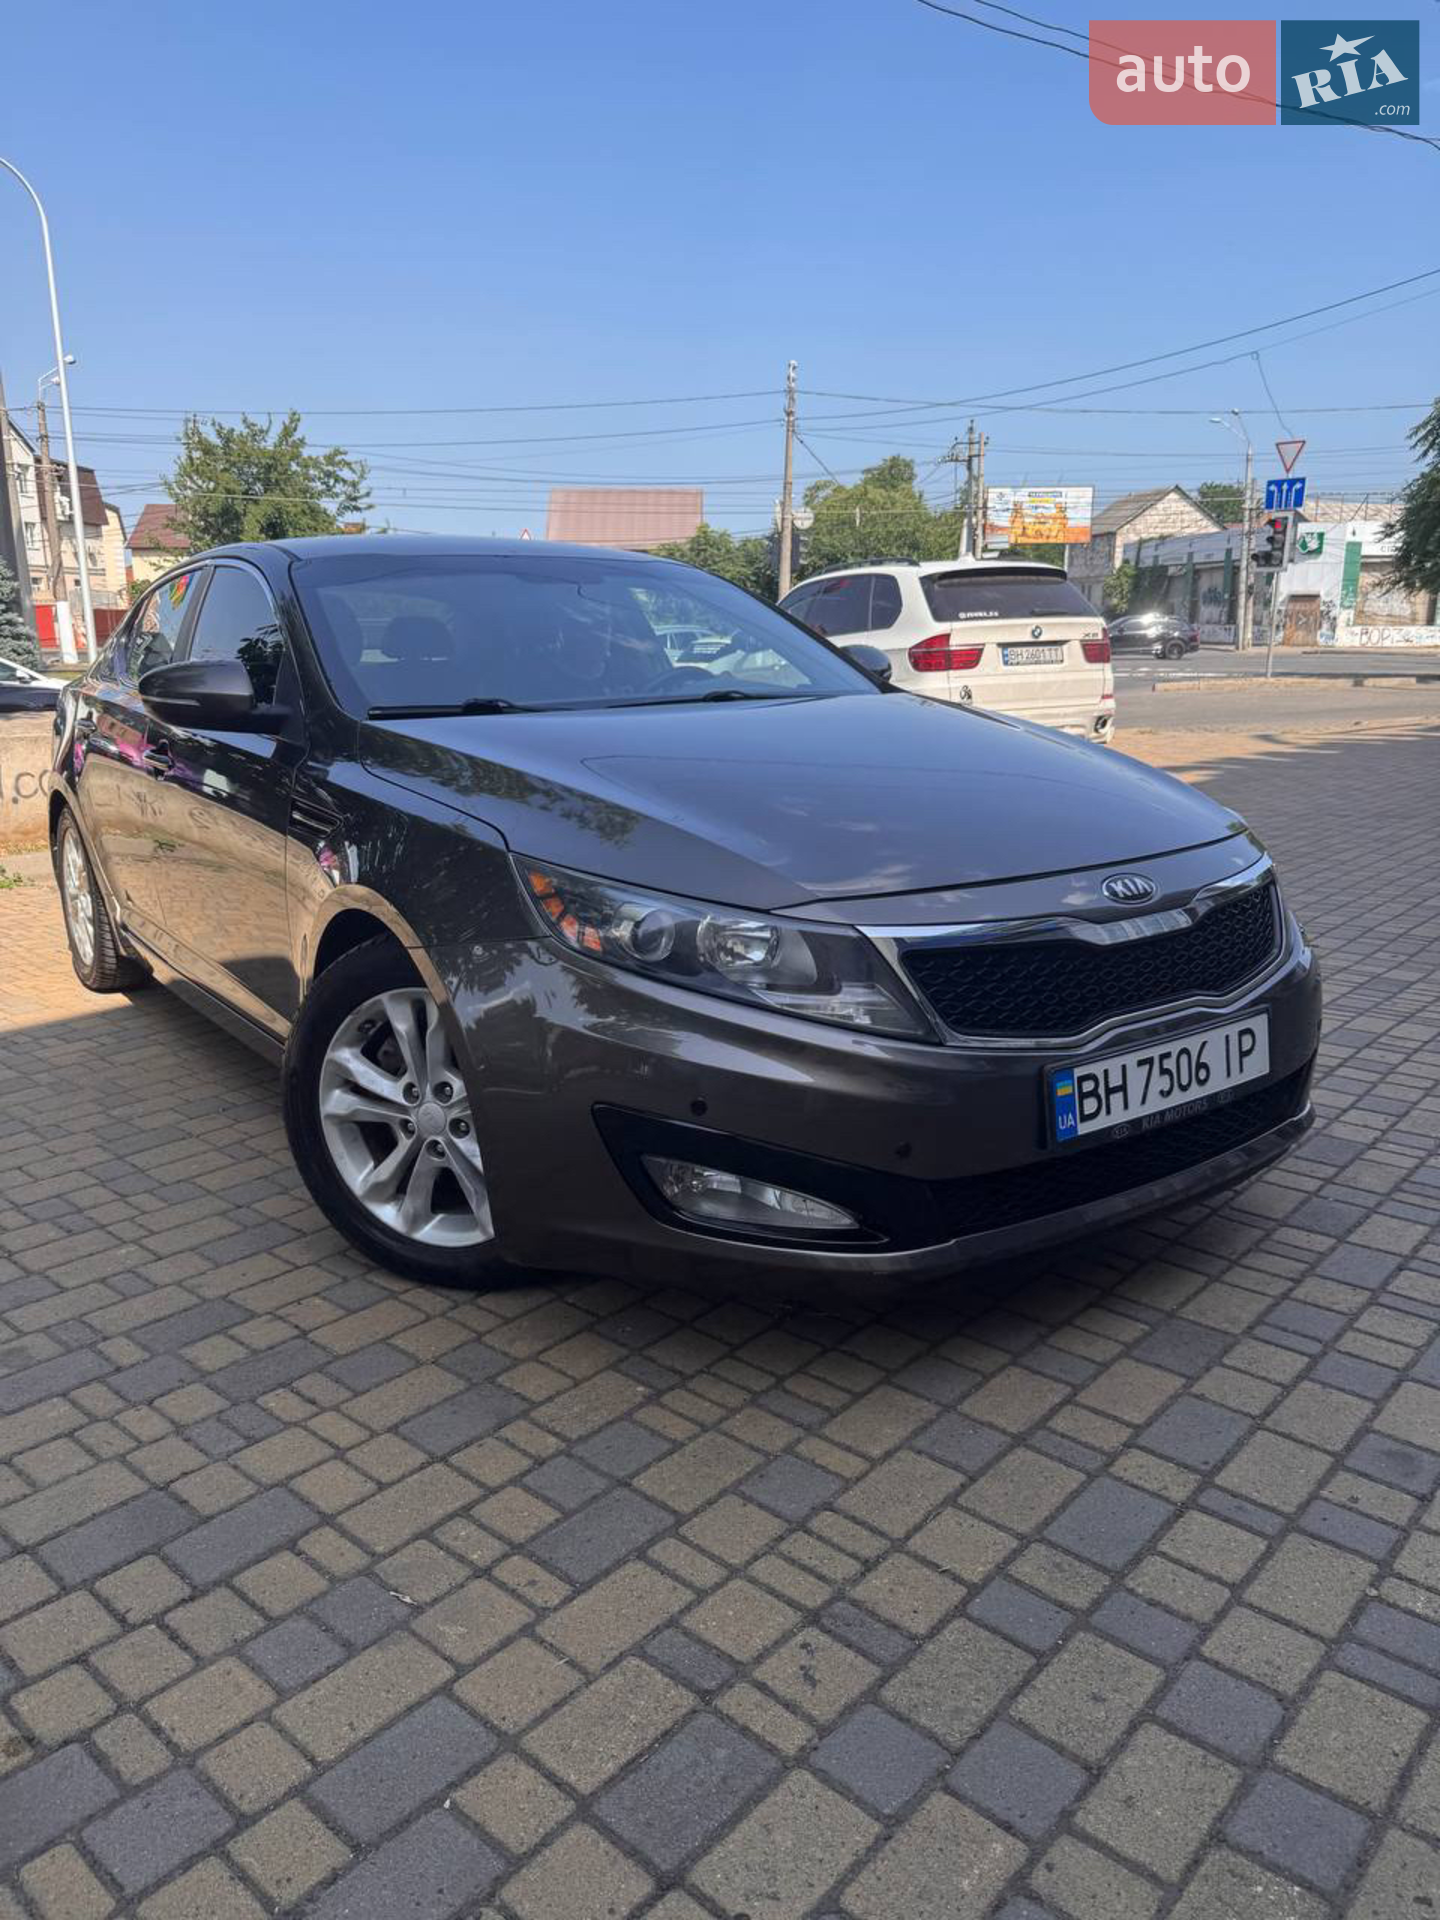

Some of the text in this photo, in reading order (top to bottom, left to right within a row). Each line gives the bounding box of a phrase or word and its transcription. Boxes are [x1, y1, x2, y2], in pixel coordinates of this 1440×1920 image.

[1108, 877, 1153, 898] KIA
[1076, 1026, 1257, 1123] BH 7506 IP
[1058, 1112, 1077, 1131] UA
[1141, 1098, 1209, 1130] KIA MOTORS
